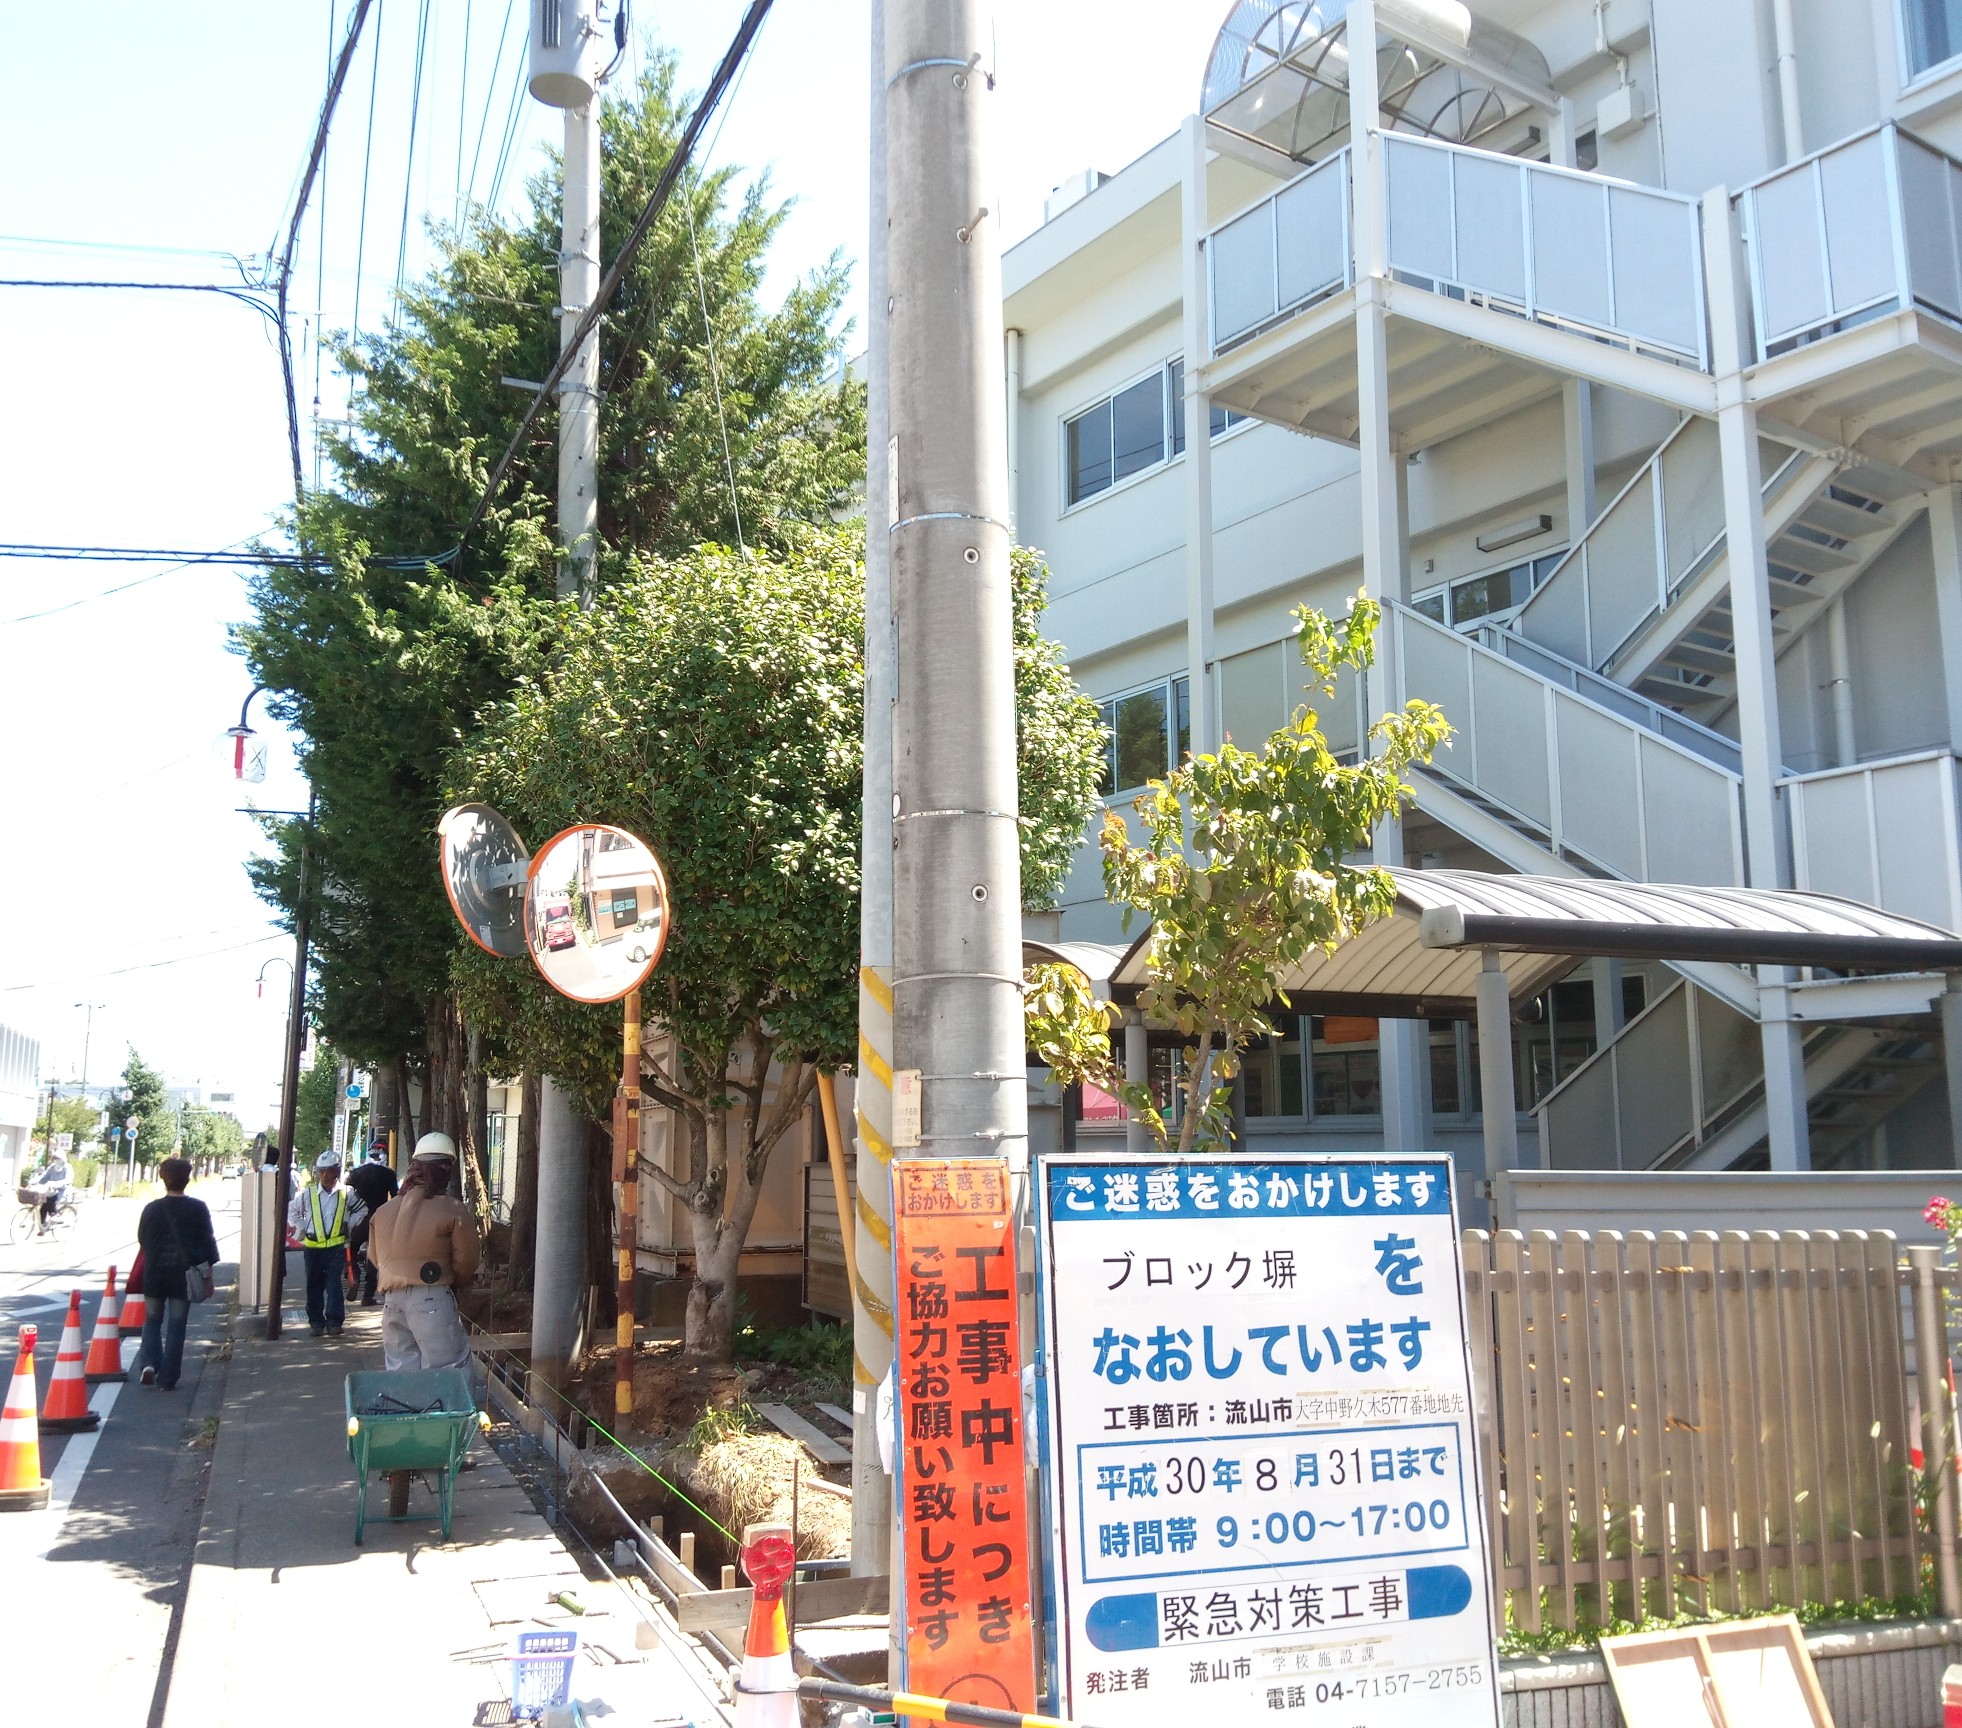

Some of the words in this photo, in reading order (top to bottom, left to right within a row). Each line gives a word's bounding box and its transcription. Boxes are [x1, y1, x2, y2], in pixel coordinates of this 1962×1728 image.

[907, 1191, 999, 1212] おかけします
[1066, 1170, 1435, 1212] ご迷惑をおかけします
[1102, 1249, 1298, 1291] ブロック塀
[1373, 1232, 1424, 1296] を
[1092, 1315, 1432, 1386] なおしています
[907, 1245, 960, 1652] ご協力お願い致します
[955, 1246, 1014, 1644] 工事中につき
[1099, 1515, 1198, 1559] 時間帯
[1162, 1574, 1404, 1643] 緊急対策工事
[1085, 1666, 1151, 1696] 発注者
[1188, 1655, 1252, 1685] 流山市
[1265, 1684, 1306, 1711] 電話
